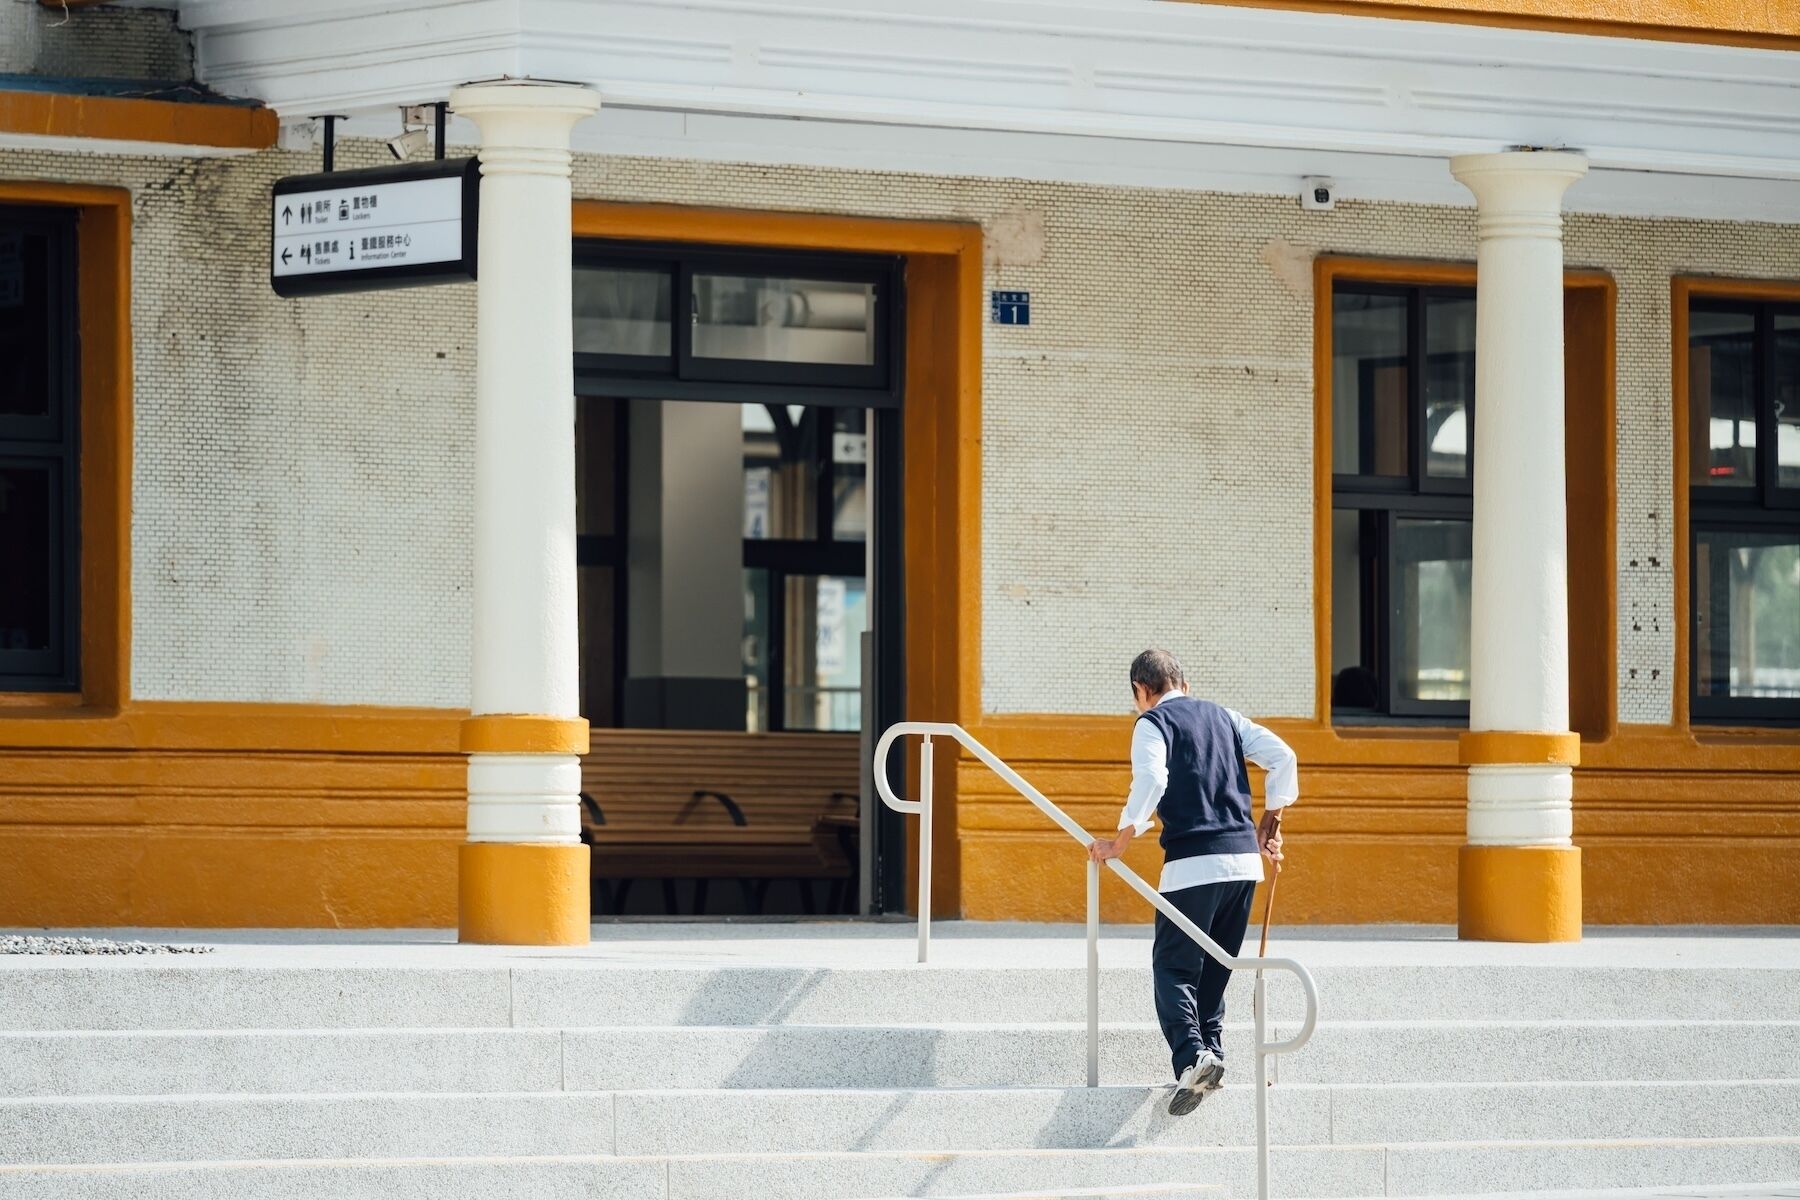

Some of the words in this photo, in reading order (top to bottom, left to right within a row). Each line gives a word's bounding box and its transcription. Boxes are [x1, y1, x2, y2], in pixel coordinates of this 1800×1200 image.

[315, 200, 331, 213] 廁所
[353, 195, 377, 210] 置物櫃
[315, 240, 339, 255] 售票處
[361, 252, 389, 260] Information
[391, 251, 407, 259] Center
[1011, 305, 1018, 324] 1
